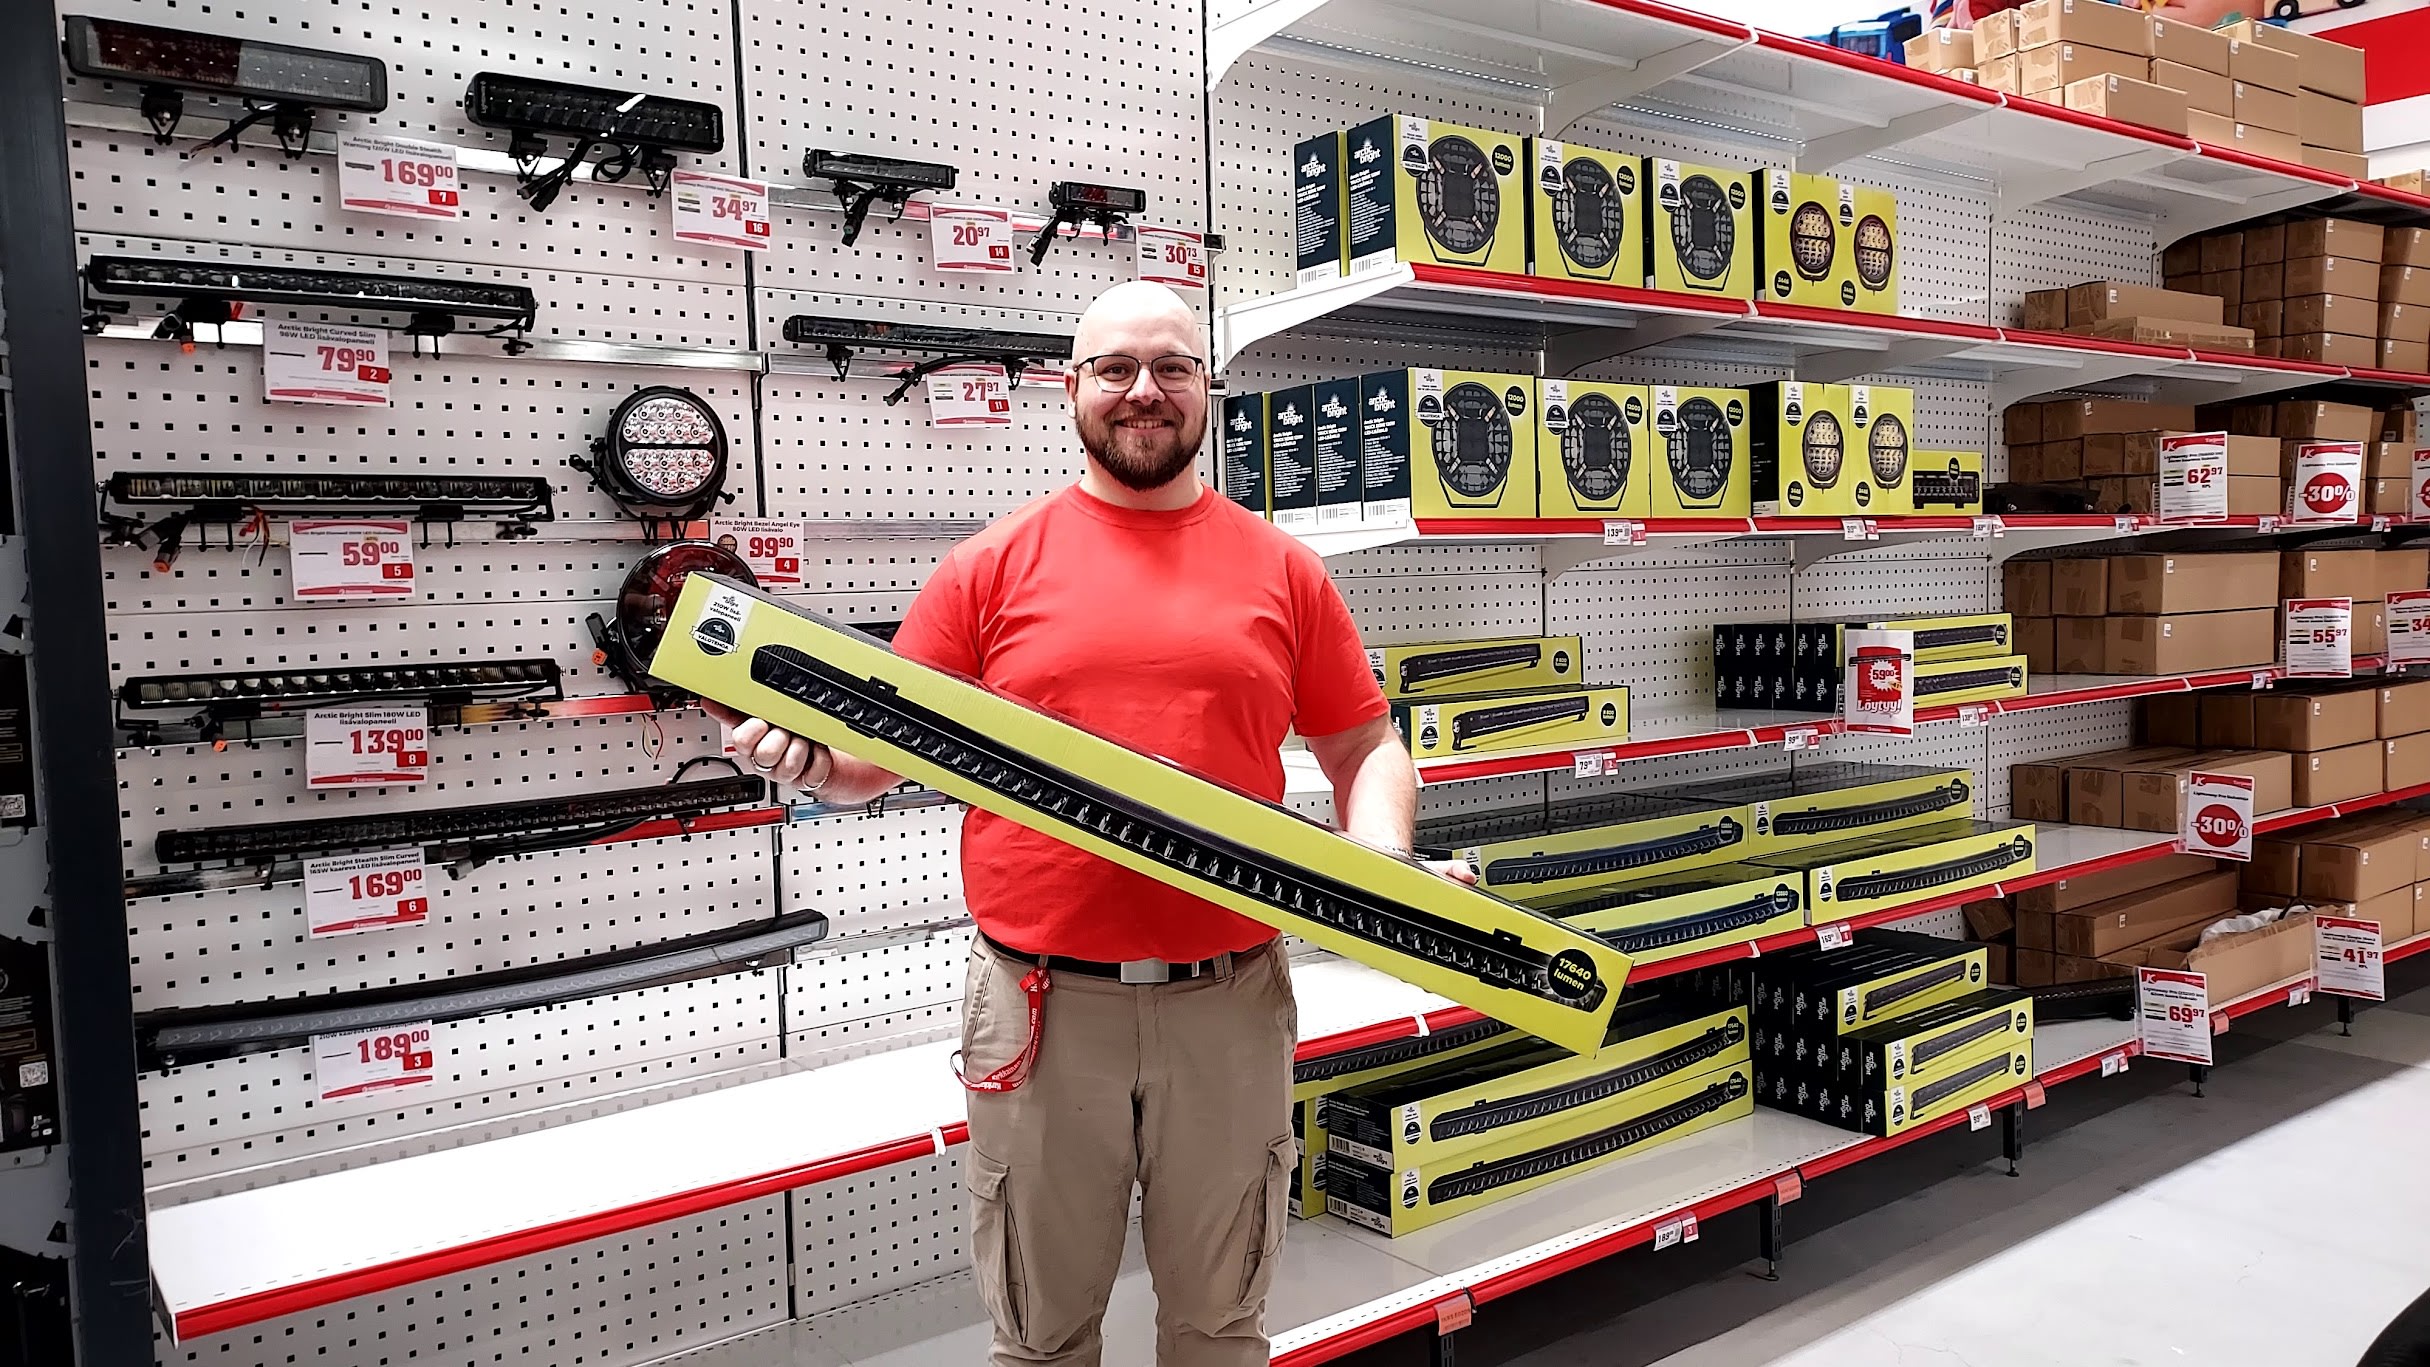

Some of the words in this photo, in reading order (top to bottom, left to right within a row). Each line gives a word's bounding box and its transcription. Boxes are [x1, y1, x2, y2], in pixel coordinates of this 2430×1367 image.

[1359, 149, 1381, 164] bright
[1495, 152, 1512, 163] 12000
[1495, 159, 1511, 170] lumen
[1306, 163, 1327, 178] bright
[753, 222, 763, 233] 16
[278, 323, 301, 332] Arctic
[303, 326, 328, 335] Bright
[329, 328, 357, 337] Curved
[300, 332, 315, 340] LED
[370, 369, 377, 379] 2
[1507, 393, 1524, 402] 12000
[1374, 399, 1396, 412] bright
[1507, 401, 1523, 410] lumen
[1327, 405, 1348, 418] bright
[1283, 414, 1304, 426] bright
[1234, 421, 1253, 432] bright
[2166, 441, 2178, 452] K
[2305, 448, 2315, 458] K
[2299, 485, 2356, 502] -30%
[783, 560, 791, 570] 4
[394, 566, 401, 576] 5
[2293, 603, 2303, 613] K
[1857, 699, 1902, 714] Löytyy!
[339, 711, 363, 720] Bright
[409, 754, 416, 764] 8
[2195, 776, 2206, 786] K
[2191, 816, 2249, 839] -30%
[332, 859, 354, 867] Bright
[396, 852, 419, 860] Curved
[409, 901, 417, 912] 6
[2321, 920, 2332, 929] K
[1559, 957, 1592, 980] 17640
[1554, 968, 1585, 991] lumen
[2146, 973, 2156, 983] K
[414, 1056, 422, 1067] 3
